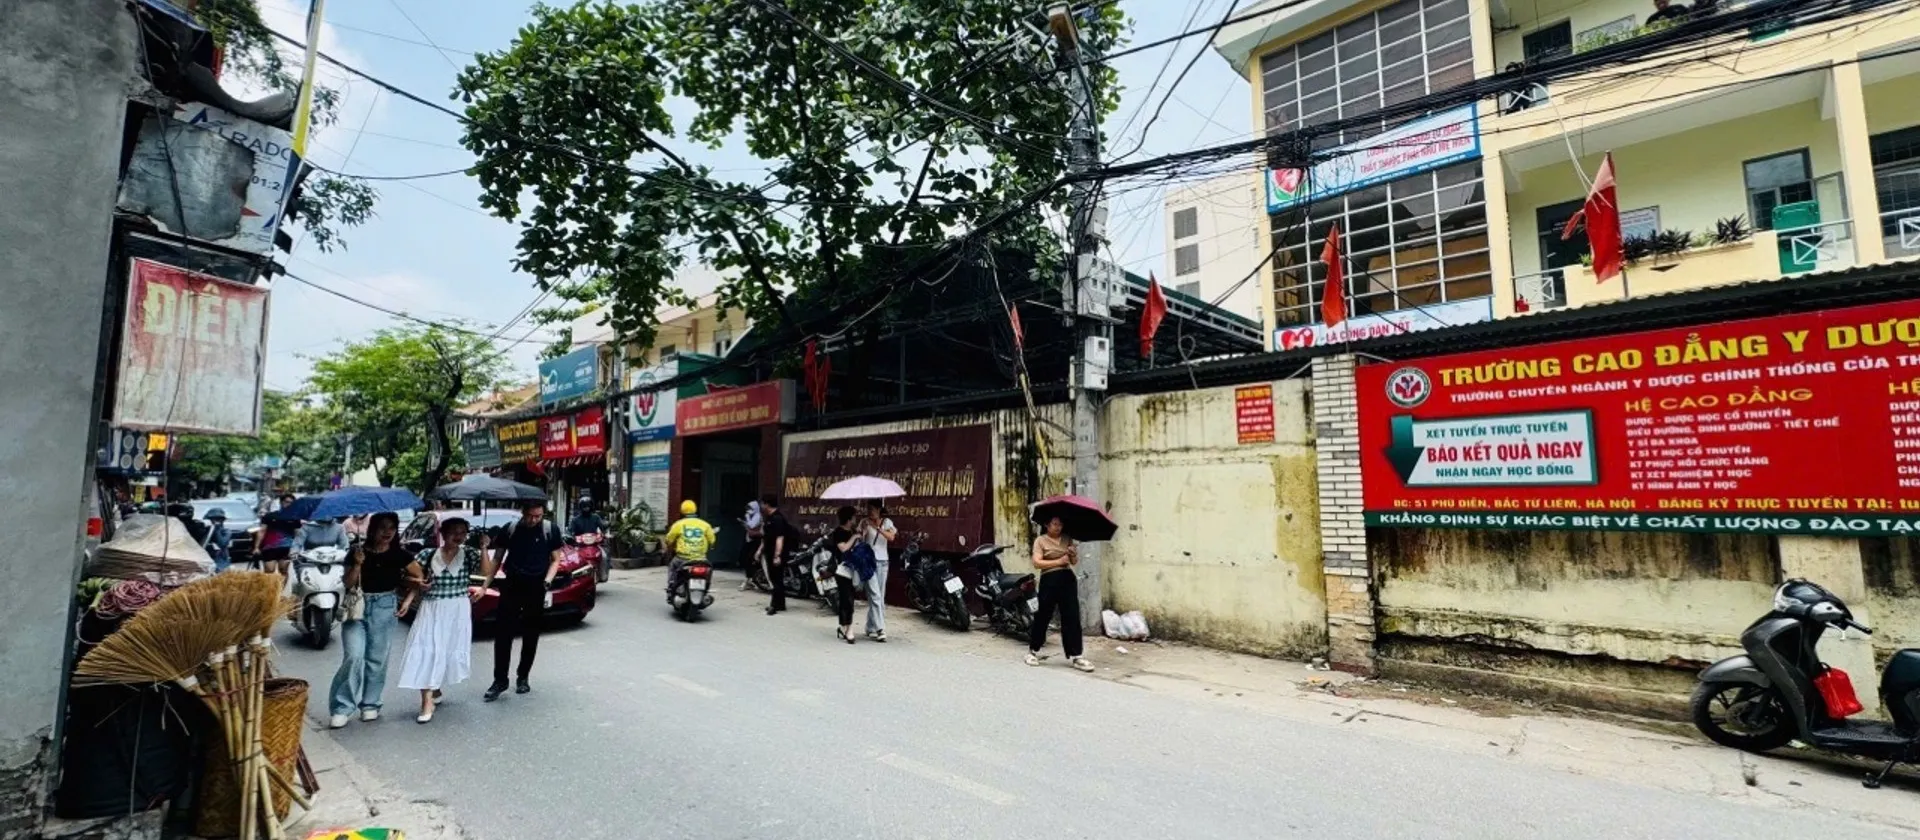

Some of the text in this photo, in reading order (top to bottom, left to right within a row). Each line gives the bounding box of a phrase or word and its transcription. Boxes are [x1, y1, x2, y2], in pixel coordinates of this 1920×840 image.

[1439, 358, 1561, 387] TRƯỜNG
[1573, 349, 1643, 374] CAO
[1654, 333, 1769, 366] ĐẲNG
[1783, 330, 1810, 352] Y
[1451, 391, 1504, 403] TRƯỜNG
[1508, 385, 1567, 399] CHUYÊN
[1571, 379, 1628, 394] NGÀNH
[1632, 379, 1643, 389] Y
[1648, 373, 1696, 388] DƯỢC
[1701, 367, 1761, 383] CHÍNH
[1766, 361, 1837, 378] THỐNG
[1843, 355, 1890, 371] CỦA
[1625, 385, 1813, 413] HỆ CAO ĐẲNG
[1491, 424, 1522, 436] TRỰC
[1427, 437, 1583, 463] BÁO KẾT QUẢ NGAY
[1472, 466, 1502, 476] NGAY
[1507, 466, 1533, 477] HỌC
[1415, 499, 1428, 508] 51
[1585, 498, 1606, 509] HÀ
[1609, 497, 1636, 510] NỘI
[1734, 497, 1780, 510] TRỰC
[1787, 495, 1848, 510] TUYẾN
[1854, 498, 1893, 511] TẠI:
[1380, 511, 1436, 525] KHẲNG
[1440, 513, 1481, 525] ĐỊNH
[1486, 513, 1509, 526] SỰ
[1513, 514, 1566, 527] KHÁC
[1572, 514, 1610, 529] BIỆT
[1614, 514, 1640, 527] VỀ
[1646, 515, 1708, 529] CHẤT
[1714, 515, 1801, 531] LƯỢNG
[1809, 515, 1870, 531] ĐÀO
